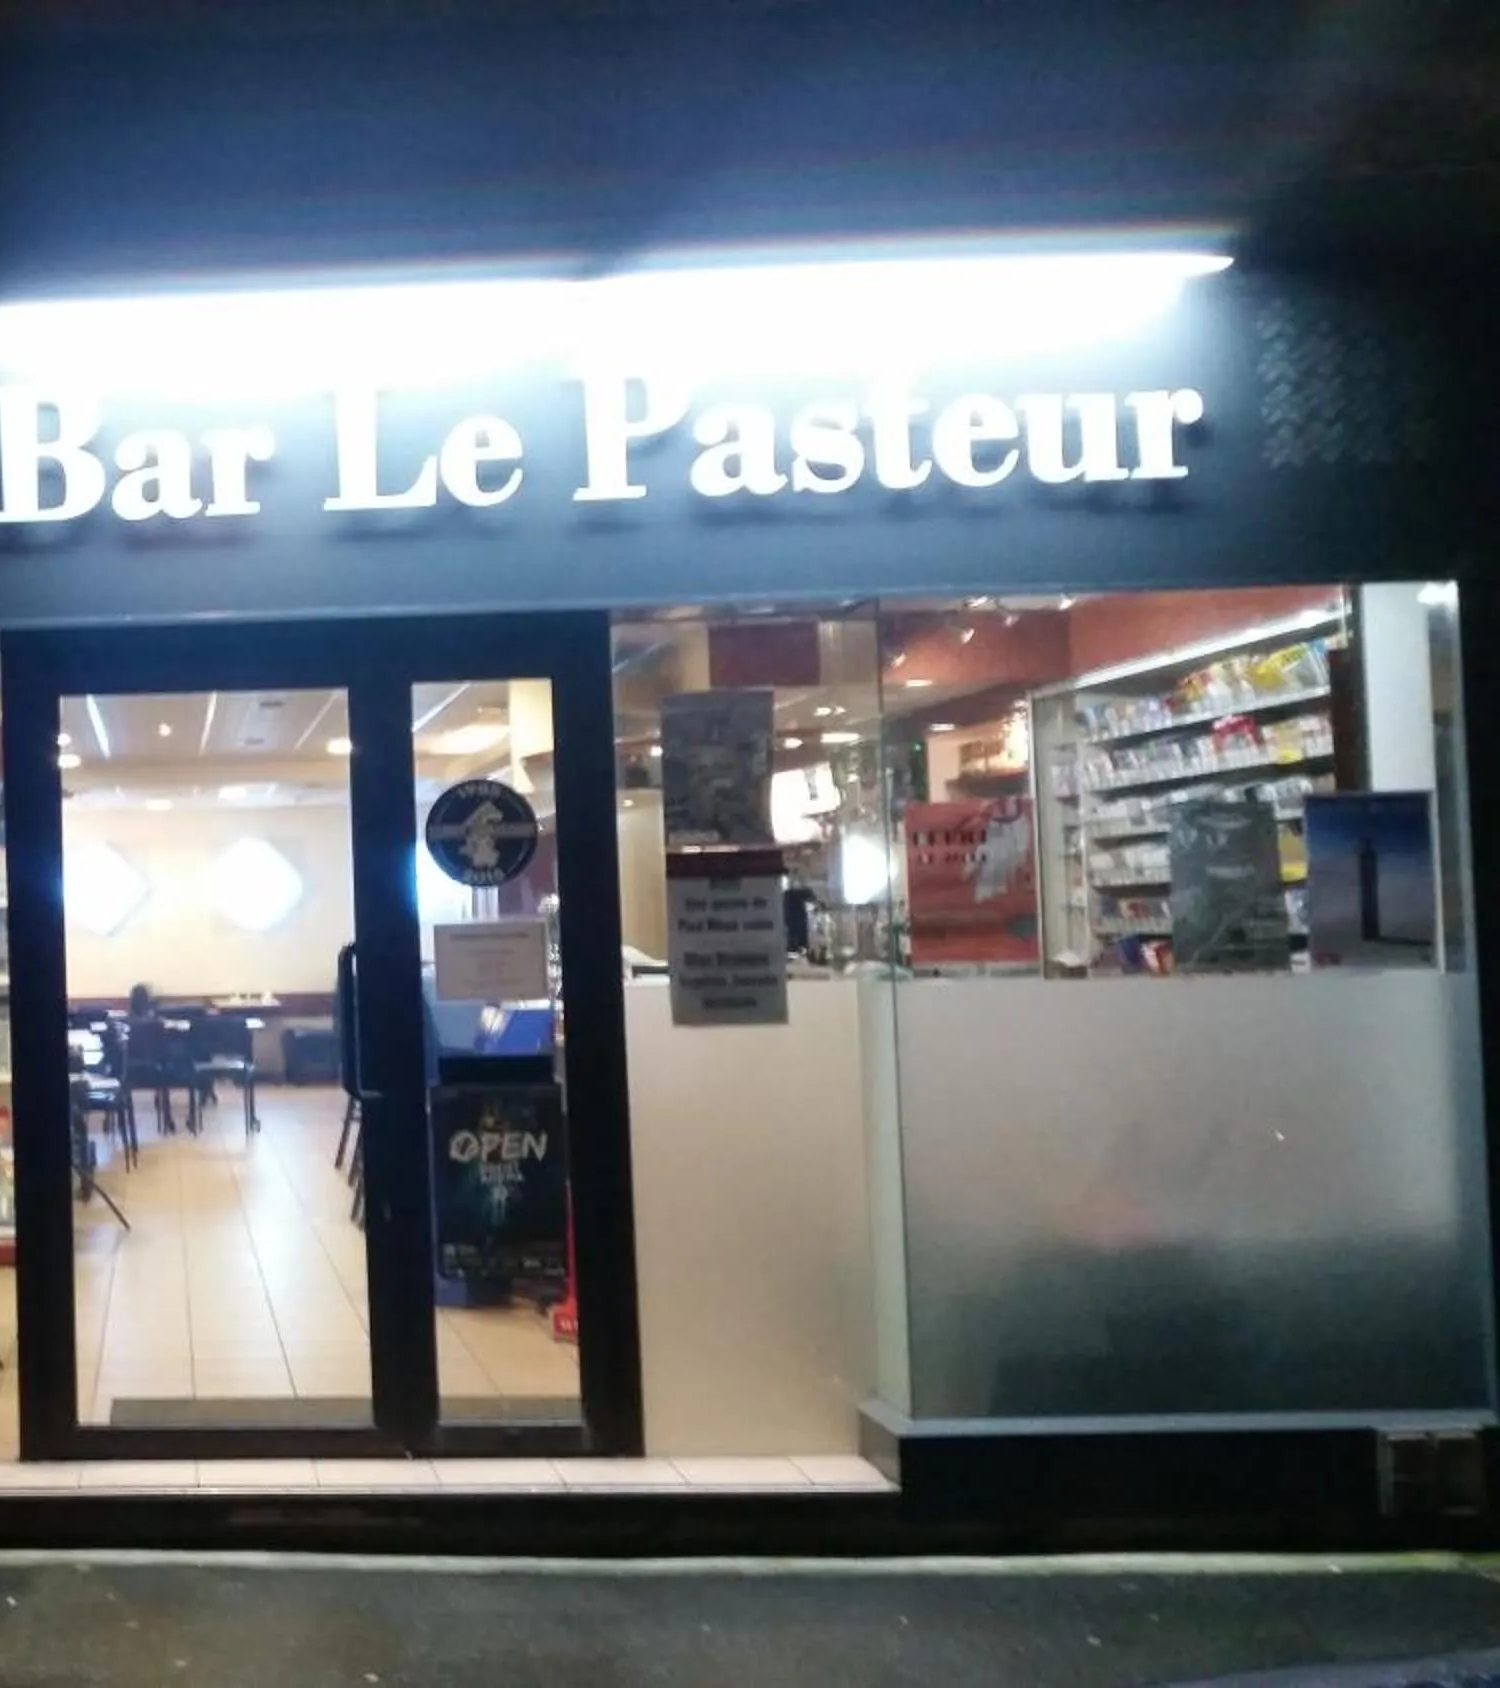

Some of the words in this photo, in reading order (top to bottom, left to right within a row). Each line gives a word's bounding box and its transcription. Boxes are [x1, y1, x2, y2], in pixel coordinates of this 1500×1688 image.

[322, 376, 524, 511] Le
[571, 362, 1205, 502] Pasteur
[449, 1129, 548, 1162] OPEN
